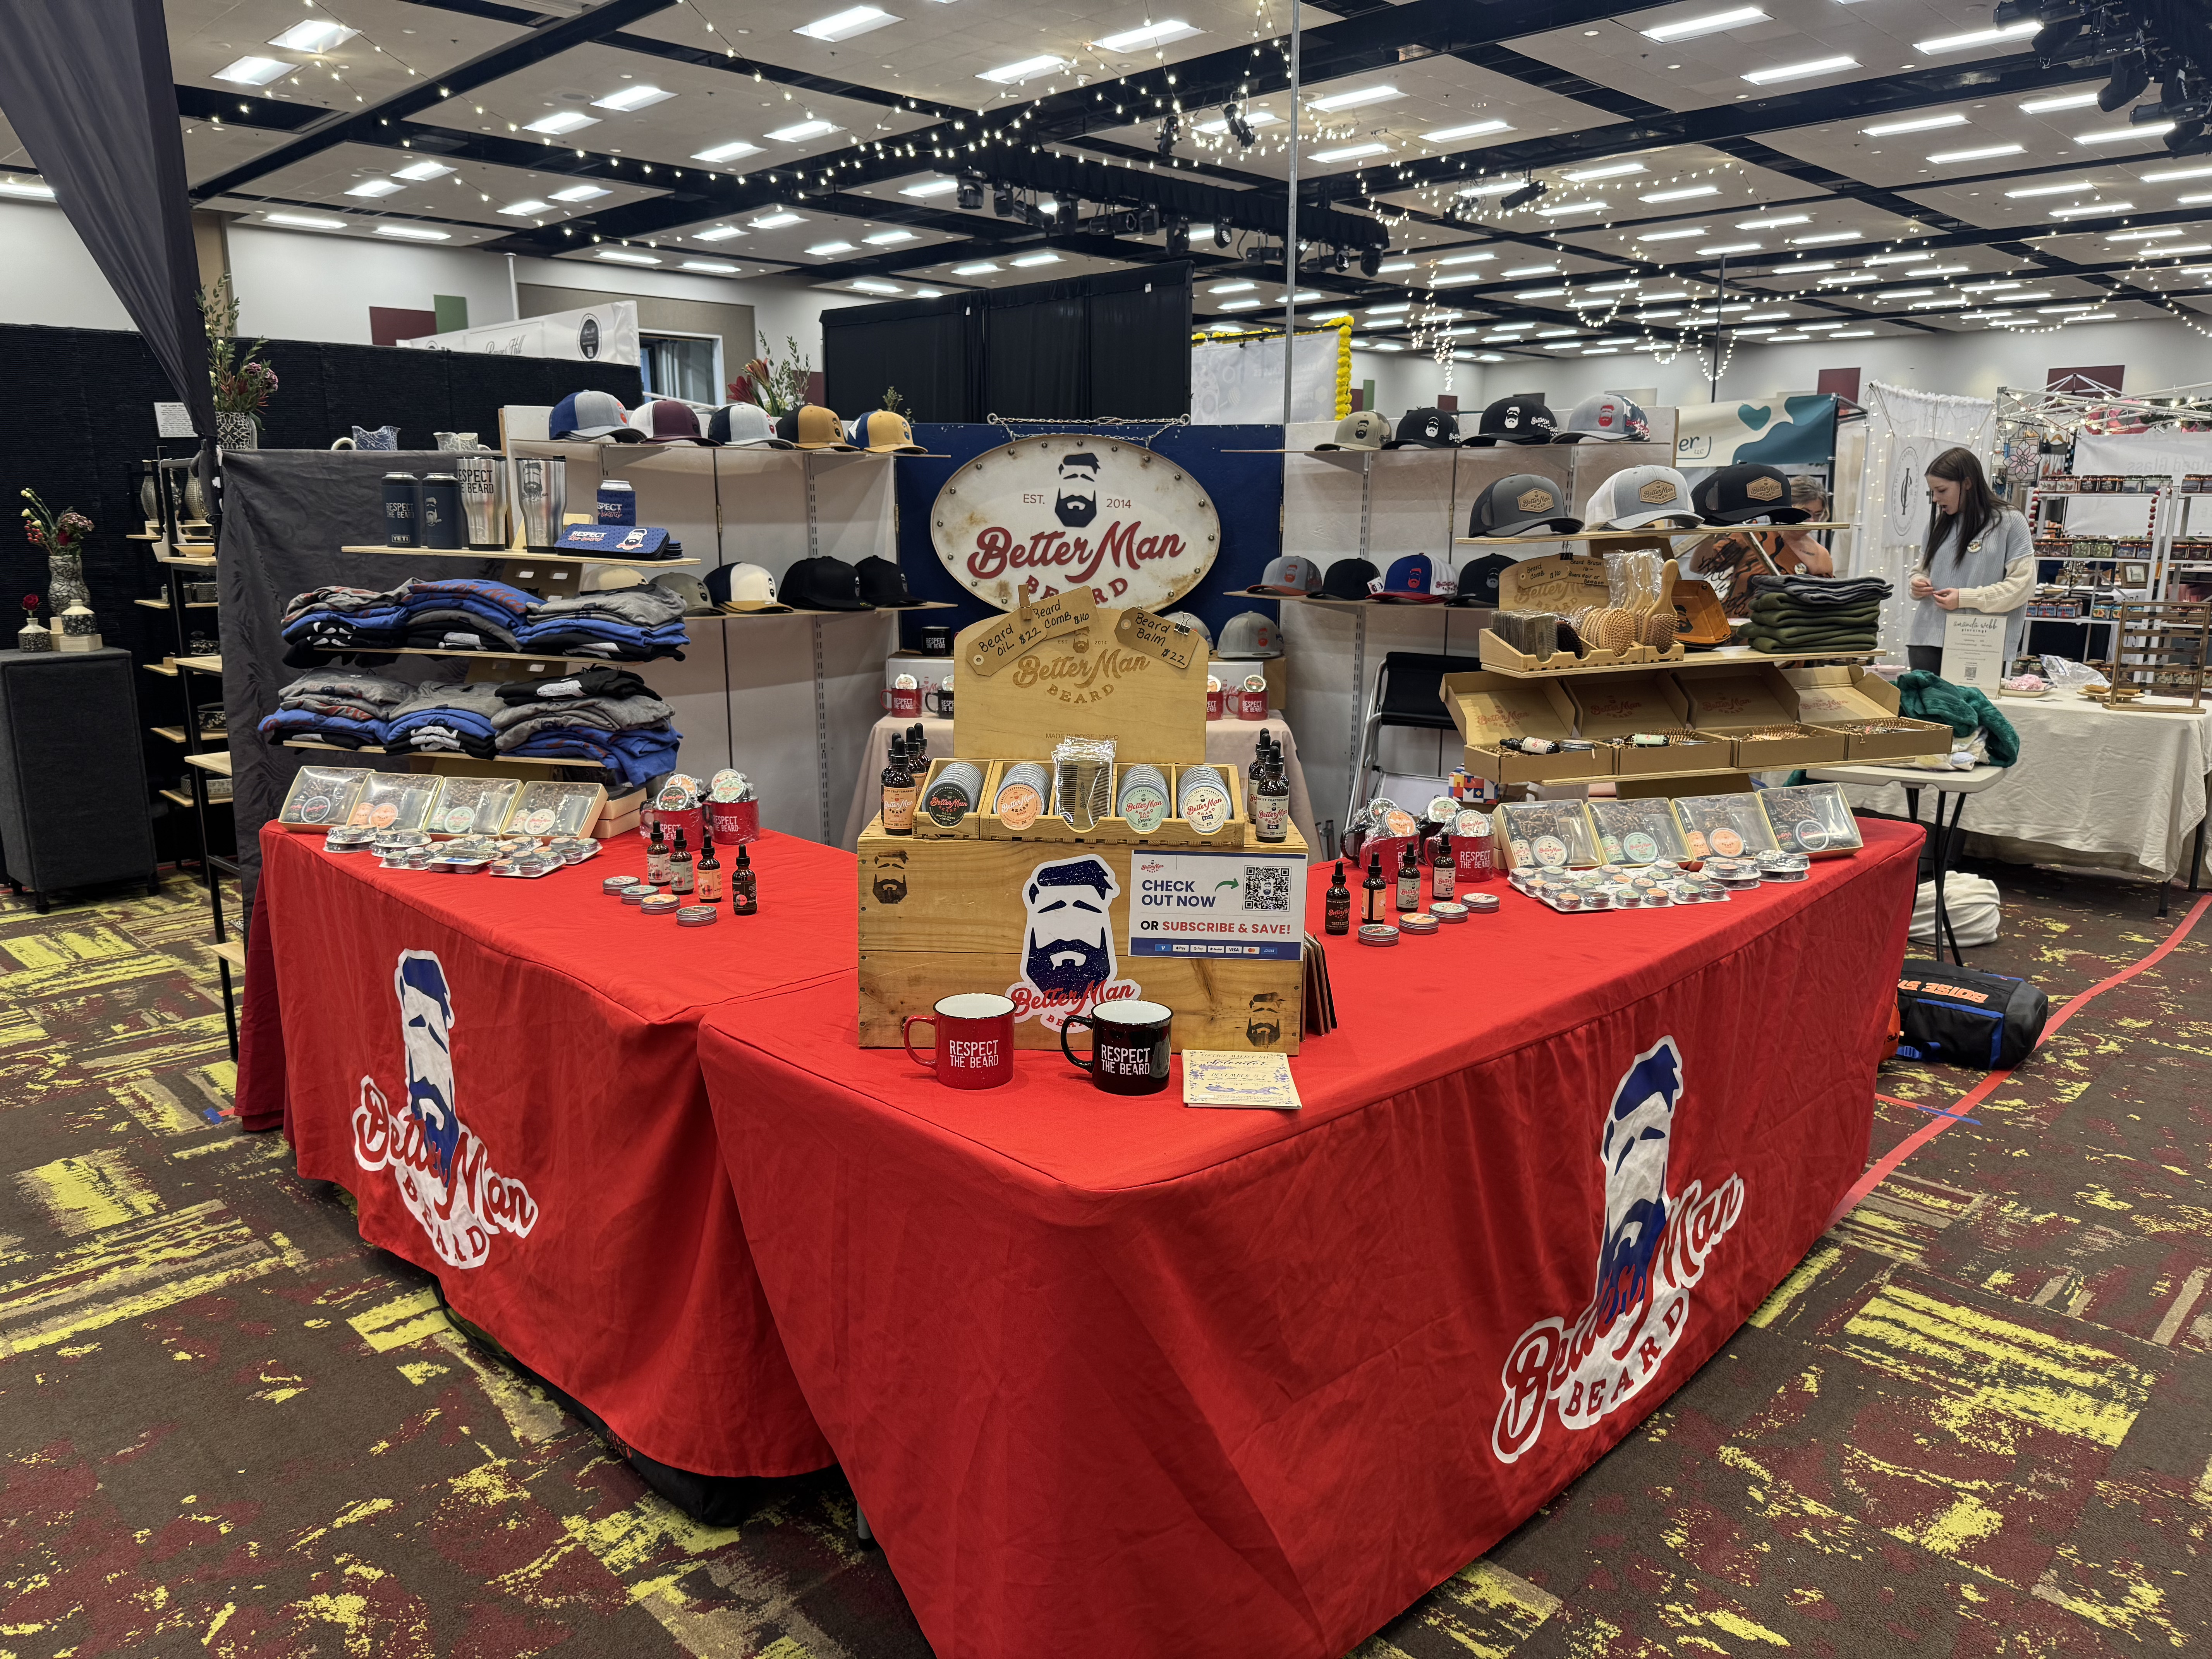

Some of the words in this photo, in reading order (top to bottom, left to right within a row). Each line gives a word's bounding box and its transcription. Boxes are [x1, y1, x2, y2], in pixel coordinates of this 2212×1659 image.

[1678, 436, 1699, 452] er
[458, 469, 493, 483] ESPECT
[468, 483, 494, 494] BEARD
[1023, 494, 1046, 505] EST.
[1106, 498, 1132, 509] 2014
[386, 503, 414, 512] RESPECT
[967, 526, 1093, 579] Better
[1065, 520, 1186, 584] Man
[1527, 562, 1542, 574] Beard
[1026, 575, 1128, 605] BERD
[1032, 599, 1061, 619] Beard
[1135, 612, 1171, 634] Beard
[1980, 618, 1997, 630] webb
[978, 623, 1014, 653] Beard
[1018, 627, 1042, 645] $22
[1161, 648, 1185, 666] $22
[1012, 654, 1091, 688] Better
[1073, 649, 1150, 689] Man
[1046, 683, 1115, 704] BEARD
[1590, 704, 1621, 715] Better
[1616, 701, 1642, 714] Man
[1703, 700, 1731, 711] Better
[1477, 714, 1508, 725] Better
[1504, 711, 1529, 723] Man
[930, 796, 952, 807] Better
[946, 798, 968, 809] Man
[1001, 799, 1021, 813] Better
[1018, 794, 1036, 808] Man
[1011, 803, 1029, 812] BEARD
[1126, 802, 1147, 812] Better
[1142, 800, 1163, 811] Man
[1187, 804, 1208, 815] Better
[1204, 798, 1223, 811] Man
[1258, 810, 1277, 819] Better
[1272, 808, 1288, 820] Man
[1460, 850, 1491, 861] RESPECT
[1460, 860, 1472, 869] THE
[1474, 860, 1490, 869] BEARD
[1142, 879, 1195, 893] CHECK
[1141, 895, 1173, 906] OUT
[1176, 895, 1216, 907] NOW
[1140, 920, 1159, 931] OR
[1162, 921, 1235, 933] SUBSCRIBE
[1238, 923, 1249, 934] &
[1251, 924, 1291, 935] SAVE!
[1011, 987, 1082, 1017] Better
[1064, 979, 1135, 1016] Man
[1921, 982, 1989, 1003] BOISE
[949, 1039, 999, 1057] RESPECT
[1101, 1044, 1151, 1064] RESPECT
[950, 1054, 966, 1068] THE
[970, 1054, 999, 1068] BEARD
[1101, 1059, 1115, 1074] THE
[1120, 1061, 1150, 1075] BEARD
[434, 1132, 534, 1229] Man
[1611, 1177, 1742, 1361] Man
[1564, 1298, 1684, 1417] BEARD
